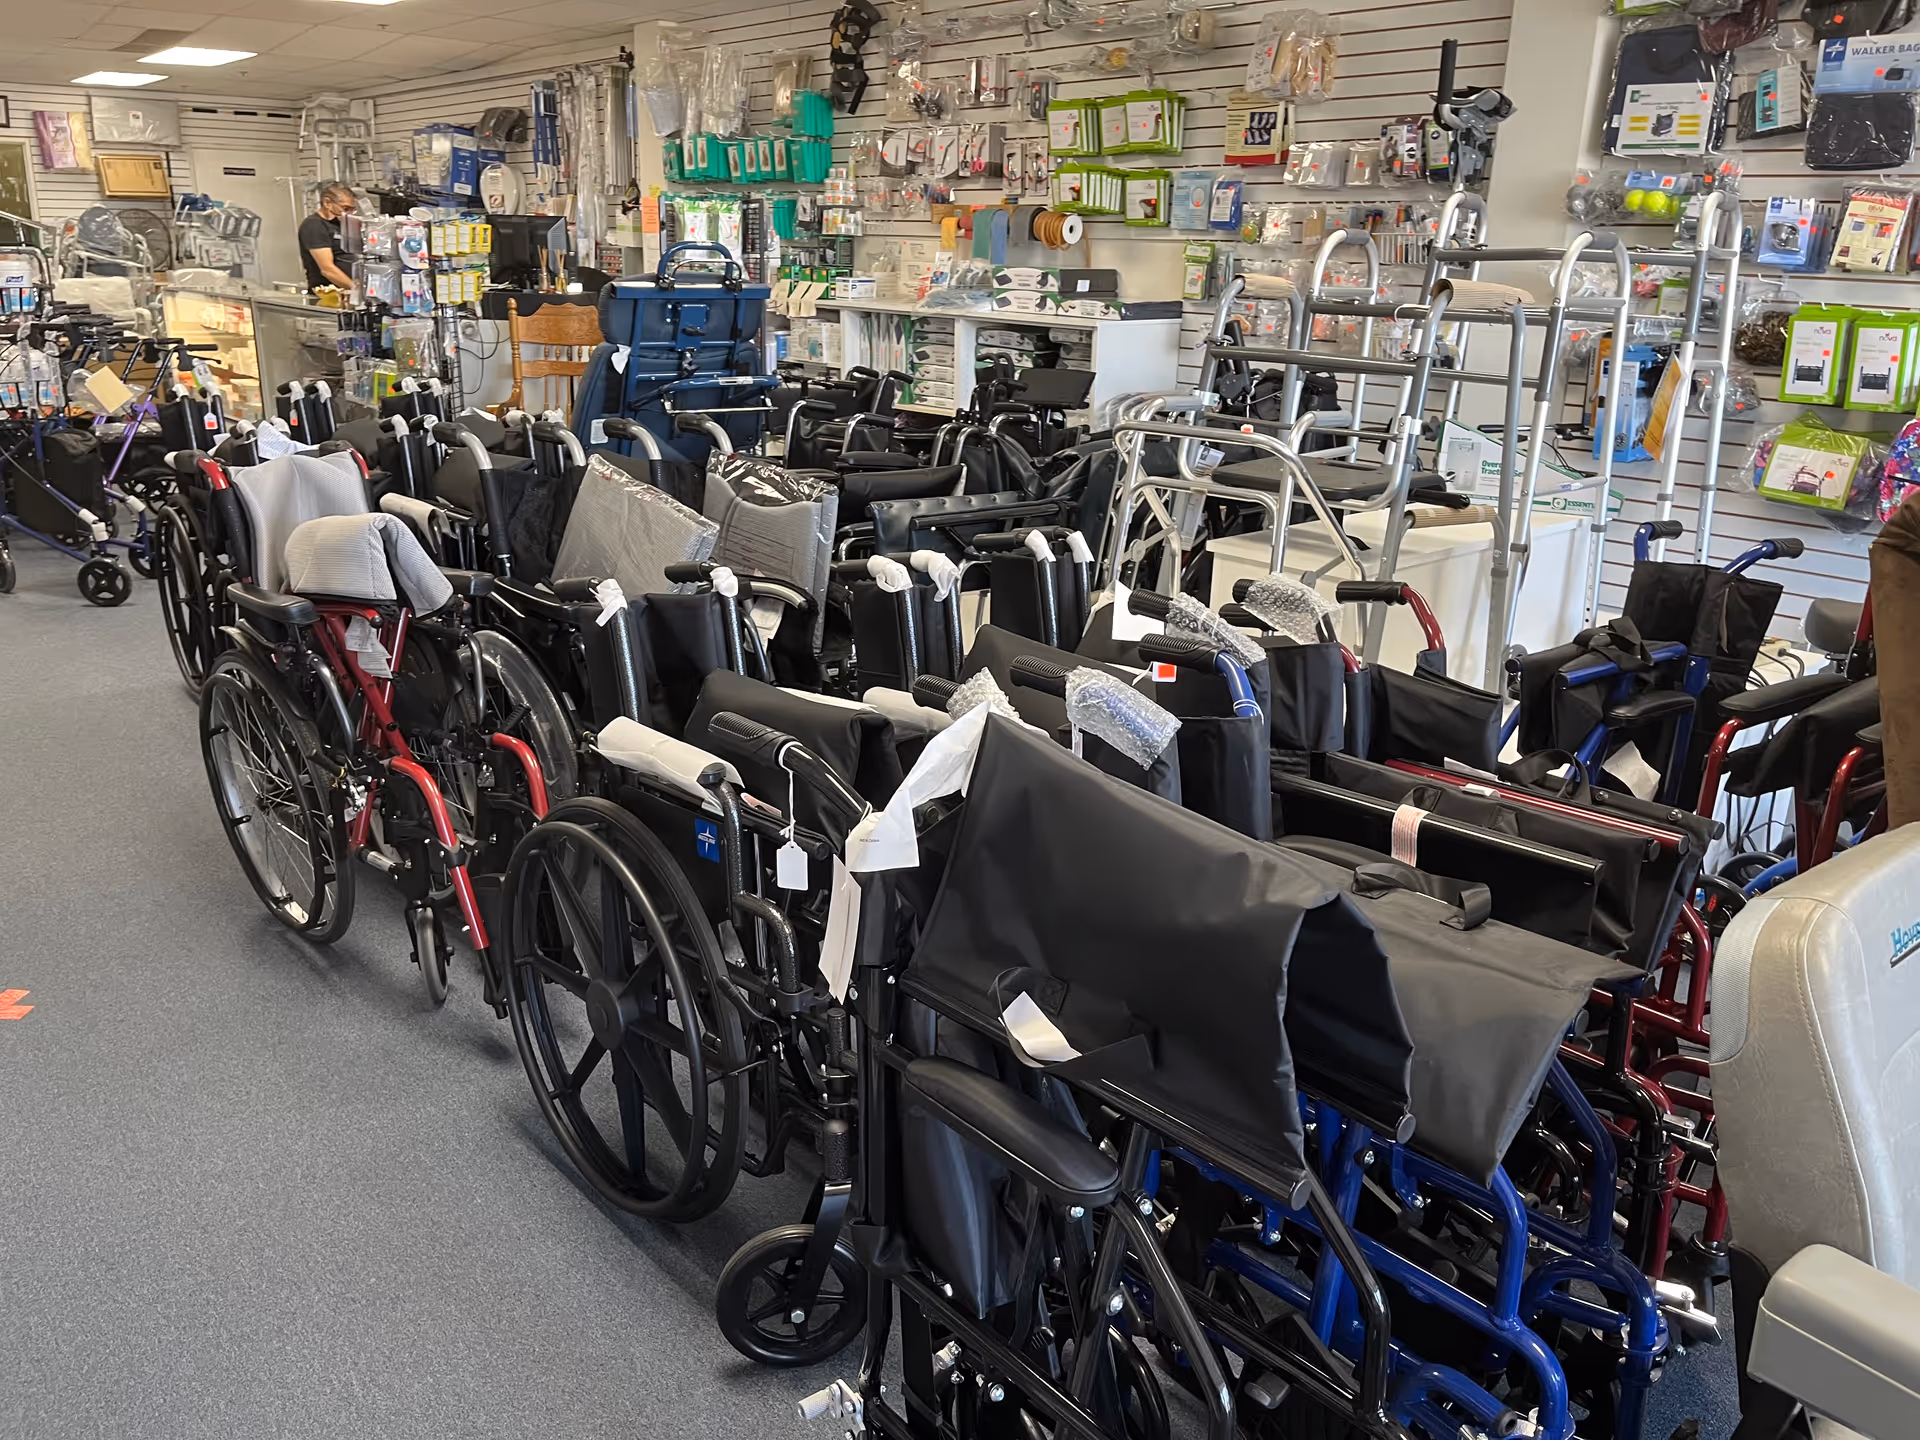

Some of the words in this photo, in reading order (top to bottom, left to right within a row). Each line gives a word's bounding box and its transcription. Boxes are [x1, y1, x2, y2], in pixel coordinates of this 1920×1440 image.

[1851, 45, 1896, 56] WALKER
[1898, 43, 1920, 53] BAG
[1813, 326, 1832, 335] nova
[1878, 333, 1898, 342] nova
[1481, 466, 1501, 476] Tract
[1513, 469, 1524, 478] Se
